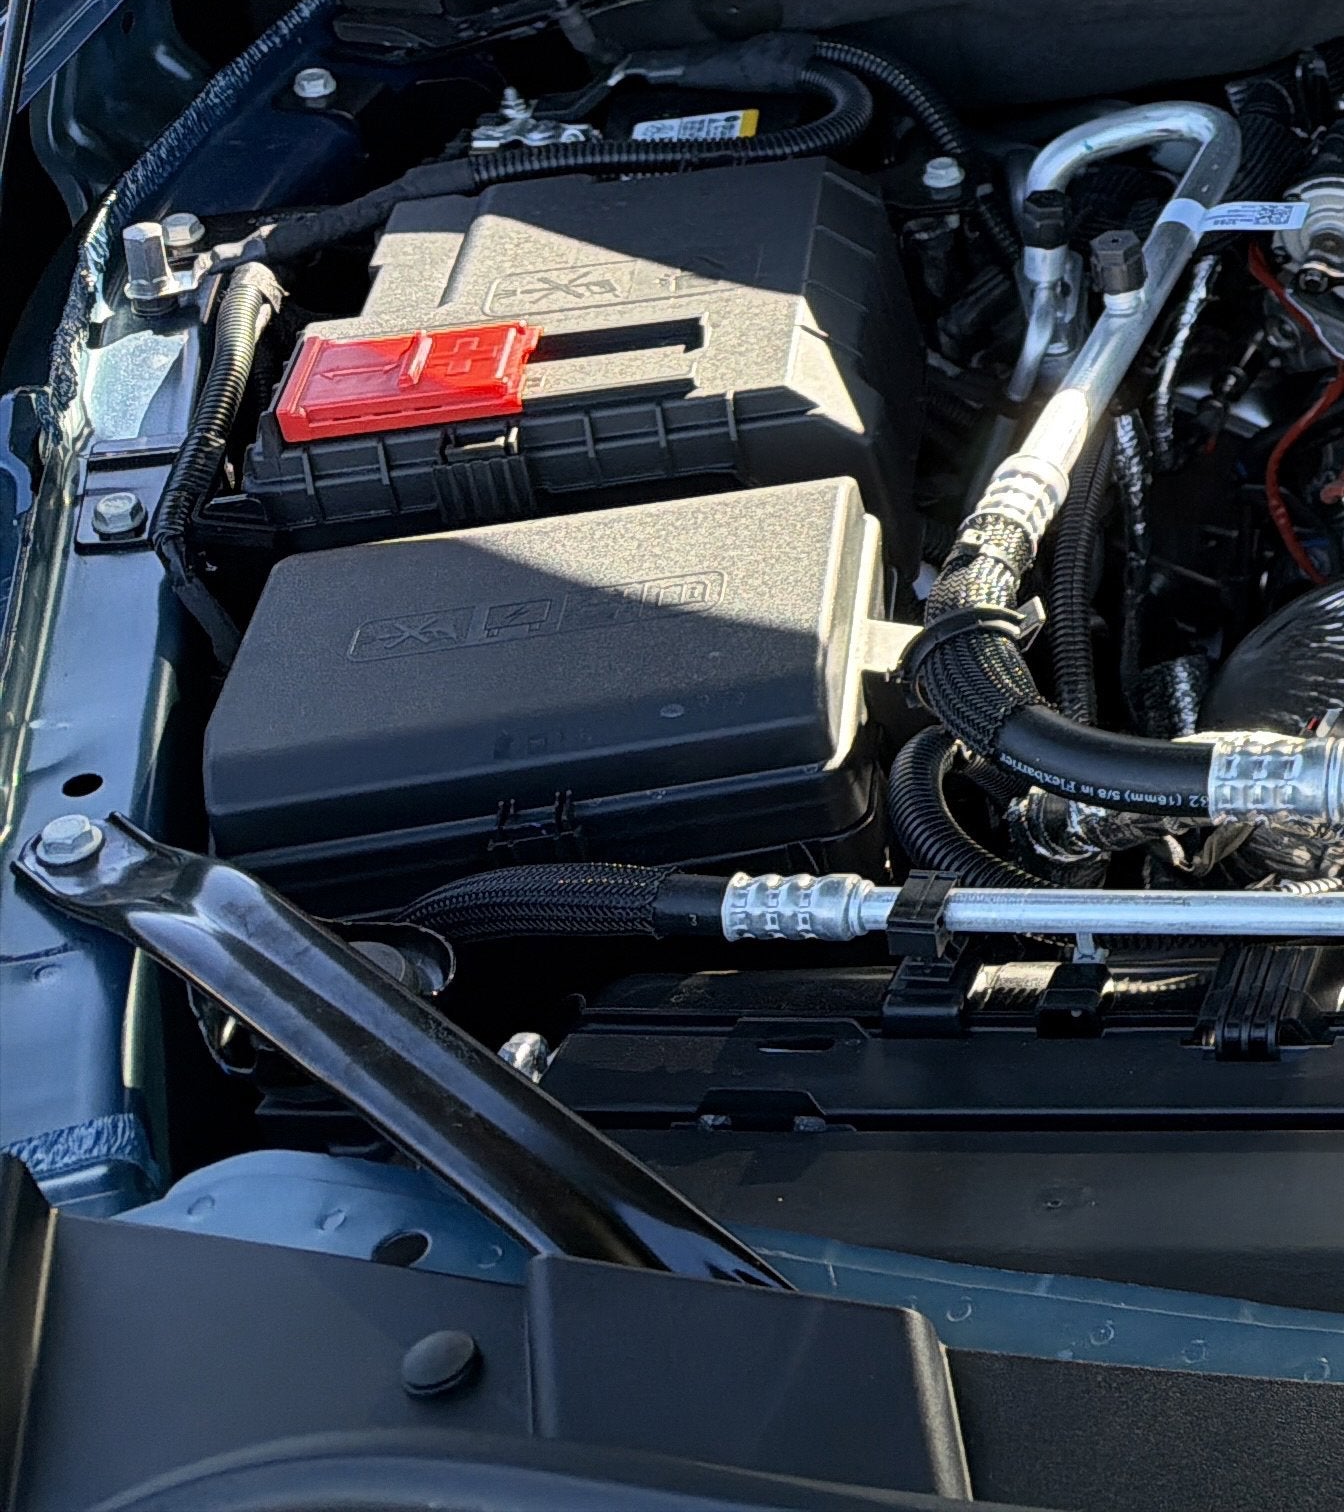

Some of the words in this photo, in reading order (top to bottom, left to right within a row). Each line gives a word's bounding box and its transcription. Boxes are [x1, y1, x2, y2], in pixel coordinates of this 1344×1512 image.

[1000, 752, 1076, 794] Flexbarrier
[1081, 784, 1094, 796] in
[1098, 789, 1120, 801] 5/8
[1124, 789, 1182, 807] (16mm)
